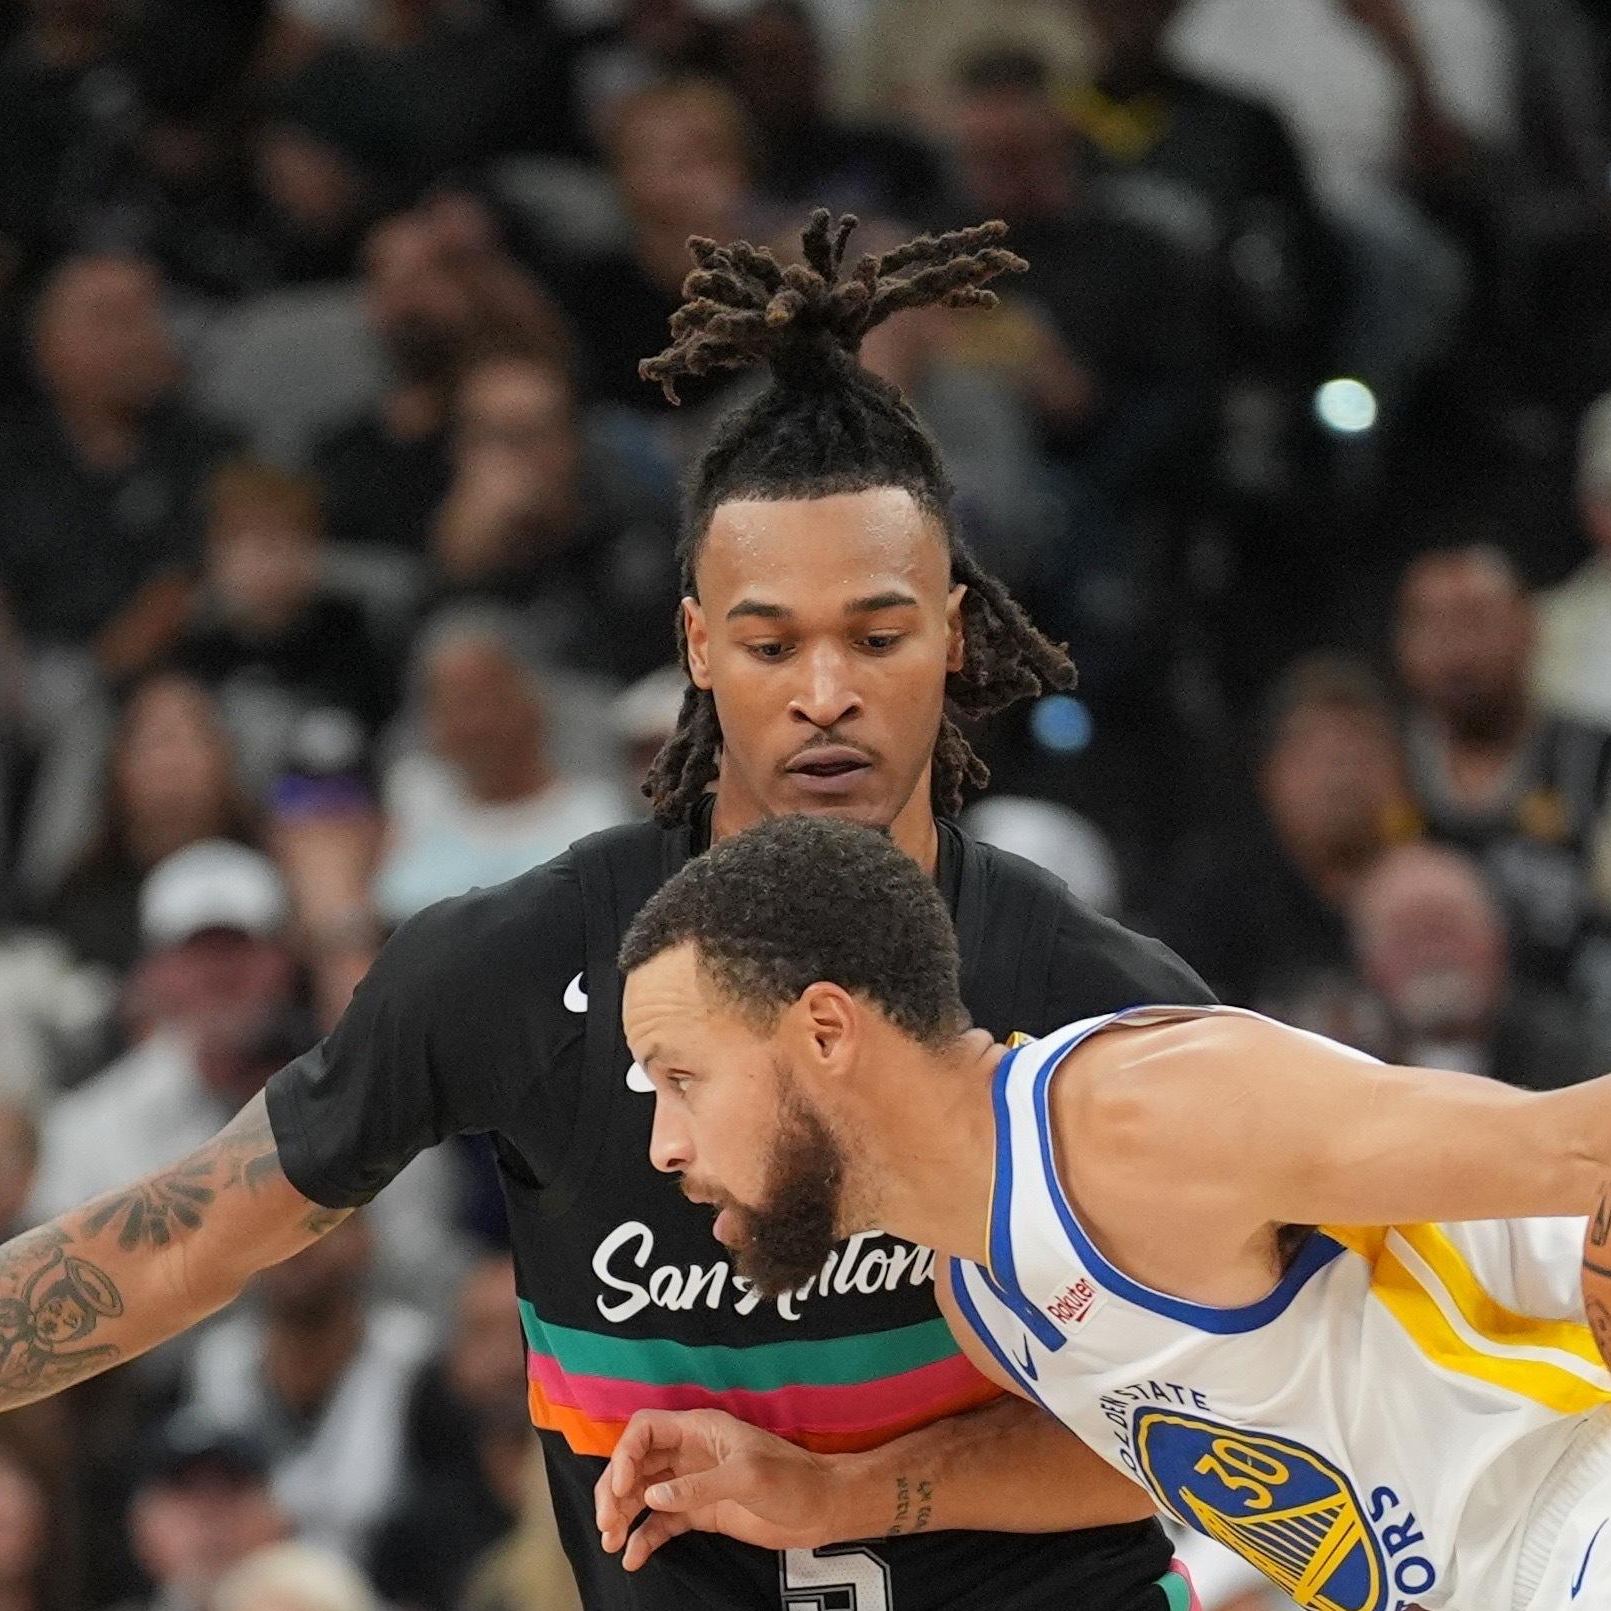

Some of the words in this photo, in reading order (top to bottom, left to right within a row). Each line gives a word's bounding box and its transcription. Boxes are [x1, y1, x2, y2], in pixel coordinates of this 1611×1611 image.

[592, 1220, 729, 1323] San
[1113, 1380, 1211, 1412] STATE
[1098, 1394, 1139, 1475] OLDEN
[1193, 1438, 1290, 1510] 30
